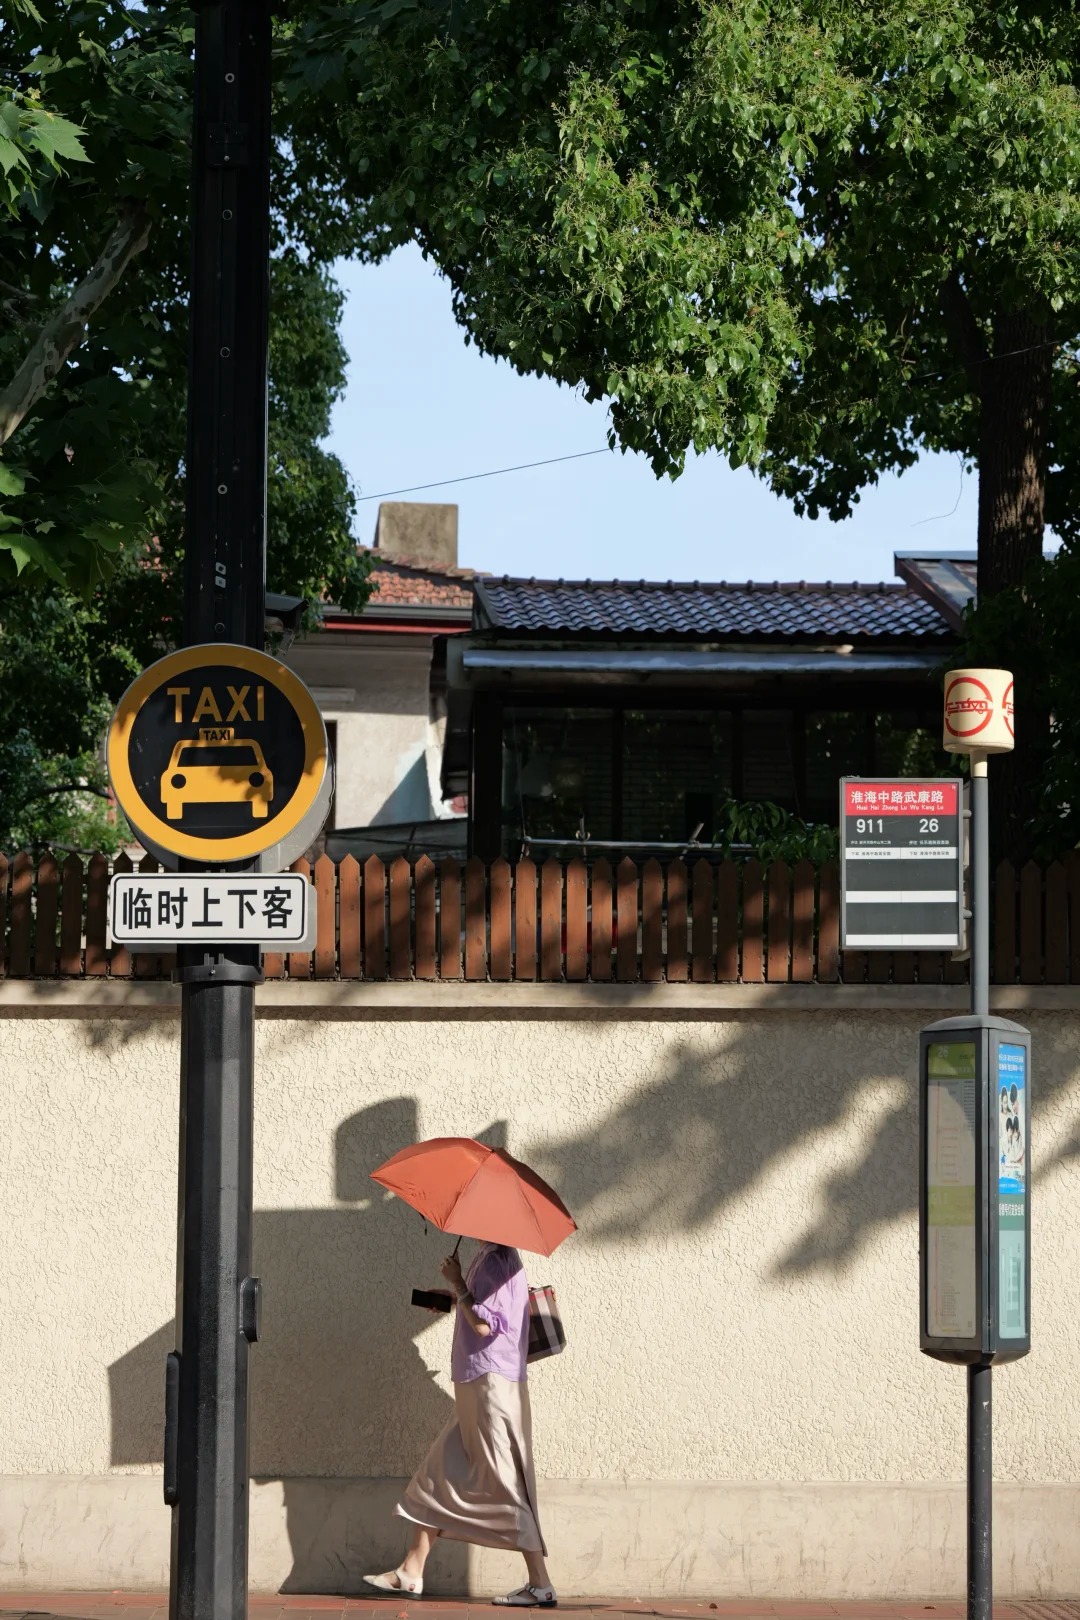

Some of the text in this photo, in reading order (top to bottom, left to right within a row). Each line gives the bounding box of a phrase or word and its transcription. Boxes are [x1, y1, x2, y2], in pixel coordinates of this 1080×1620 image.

[167, 686, 265, 723] TAXI
[203, 730, 231, 741] TAXI
[851, 790, 944, 804] 淮海中路武康路
[882, 804, 898, 812] Zhong
[921, 804, 935, 812] Kang
[856, 818, 939, 833] 911 26
[122, 886, 293, 930] 临时上下客
